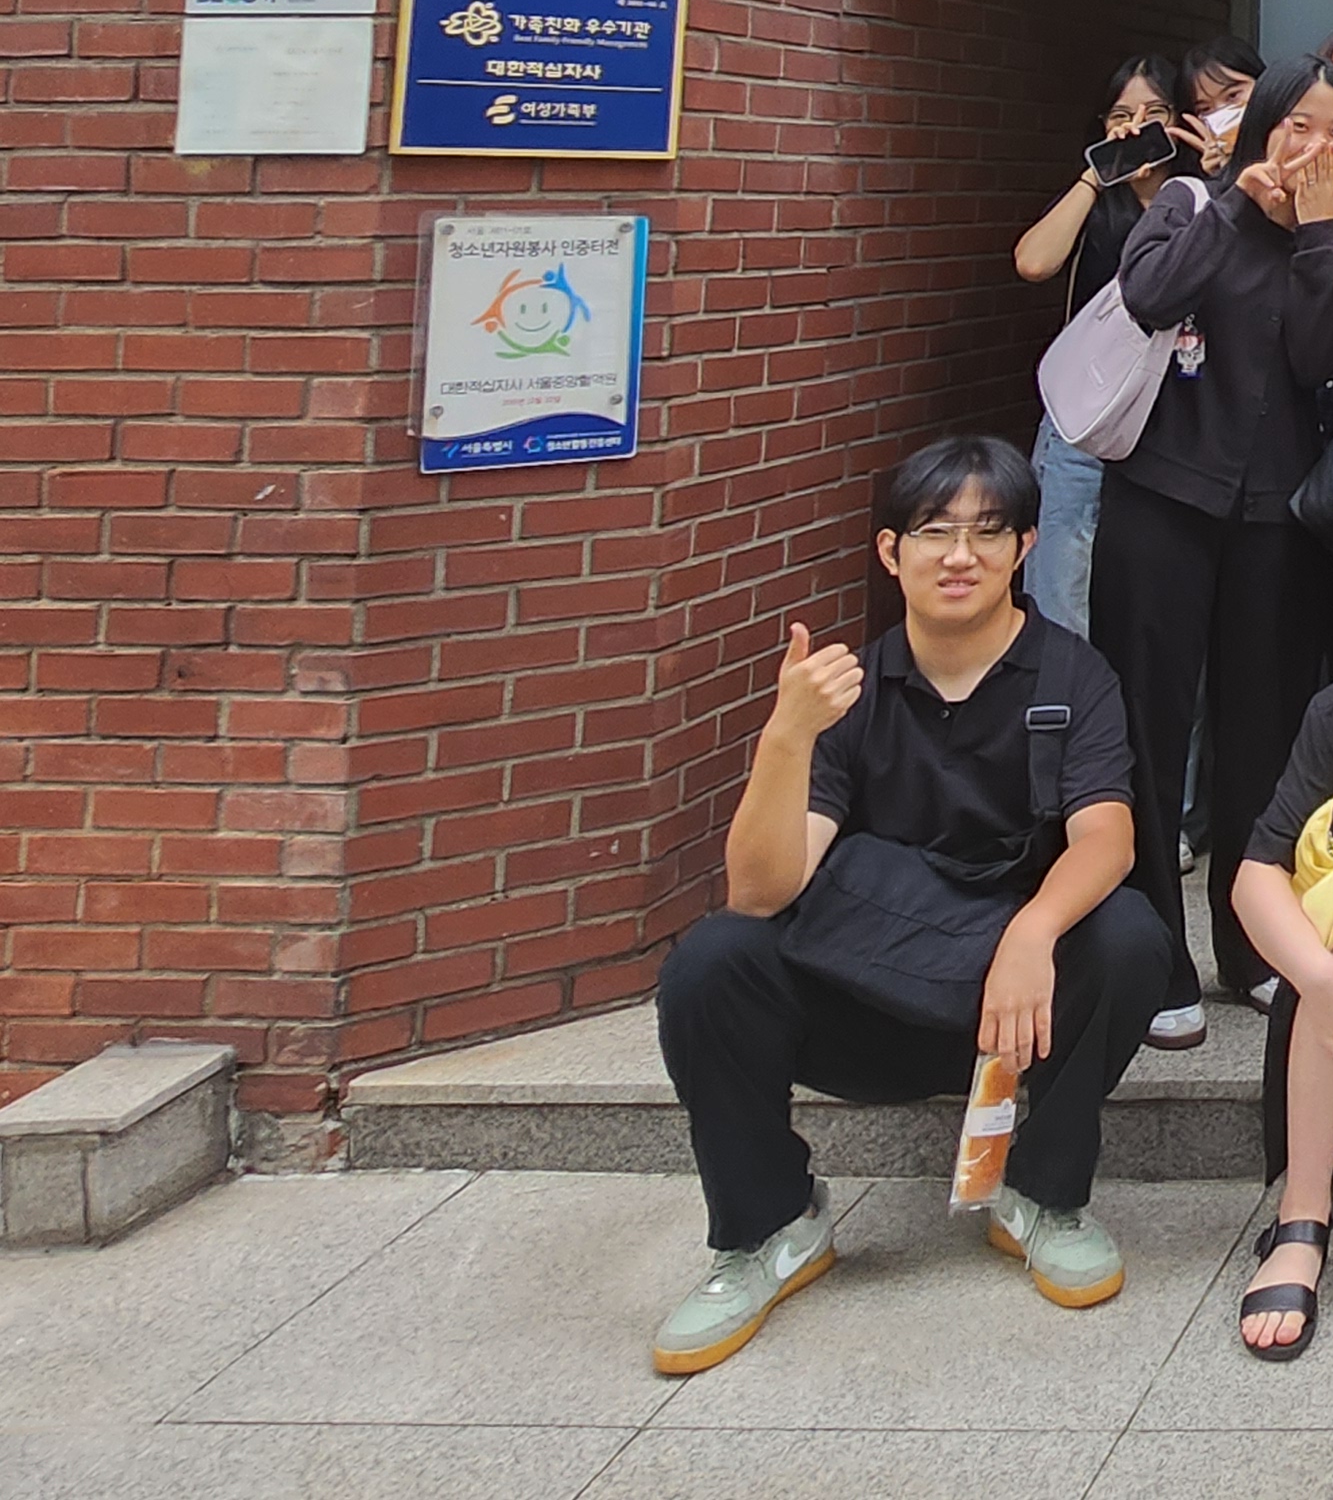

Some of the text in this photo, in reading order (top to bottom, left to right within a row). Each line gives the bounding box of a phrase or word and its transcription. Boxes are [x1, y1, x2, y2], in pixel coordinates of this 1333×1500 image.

[508, 14, 652, 40] 가족친화 우수기관
[486, 59, 602, 81] 대한적십자사
[520, 101, 598, 119] 여성가족부
[450, 238, 619, 259] 청소년자원봉사 인증터전
[440, 373, 618, 396] 대한적십자사 서울중앙혈액원
